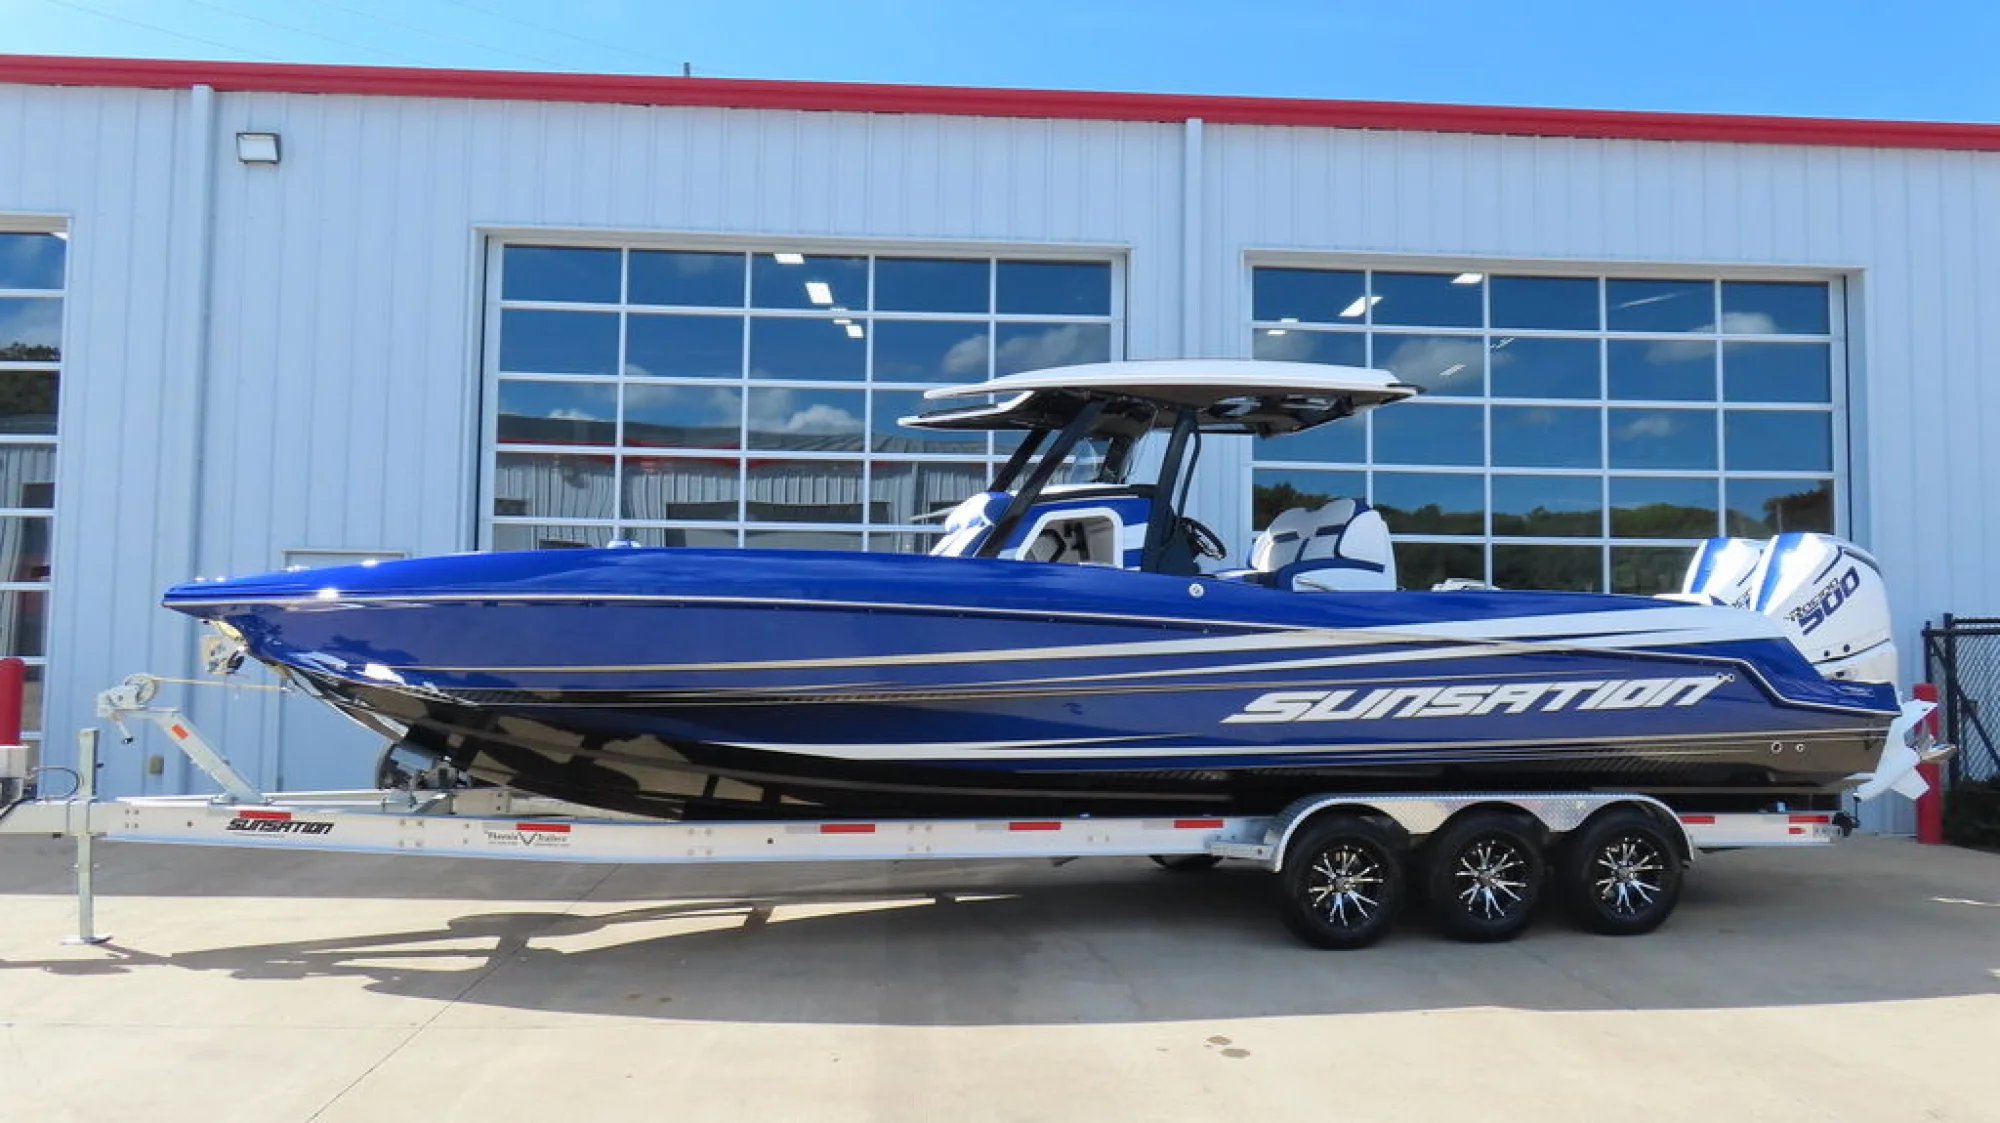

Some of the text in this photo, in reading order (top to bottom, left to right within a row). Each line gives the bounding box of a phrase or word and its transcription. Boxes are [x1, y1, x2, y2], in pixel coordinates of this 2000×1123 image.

[1798, 565, 1860, 636] 500
[1219, 676, 1730, 724] SUNSATION
[226, 818, 335, 834] SUNSATION
